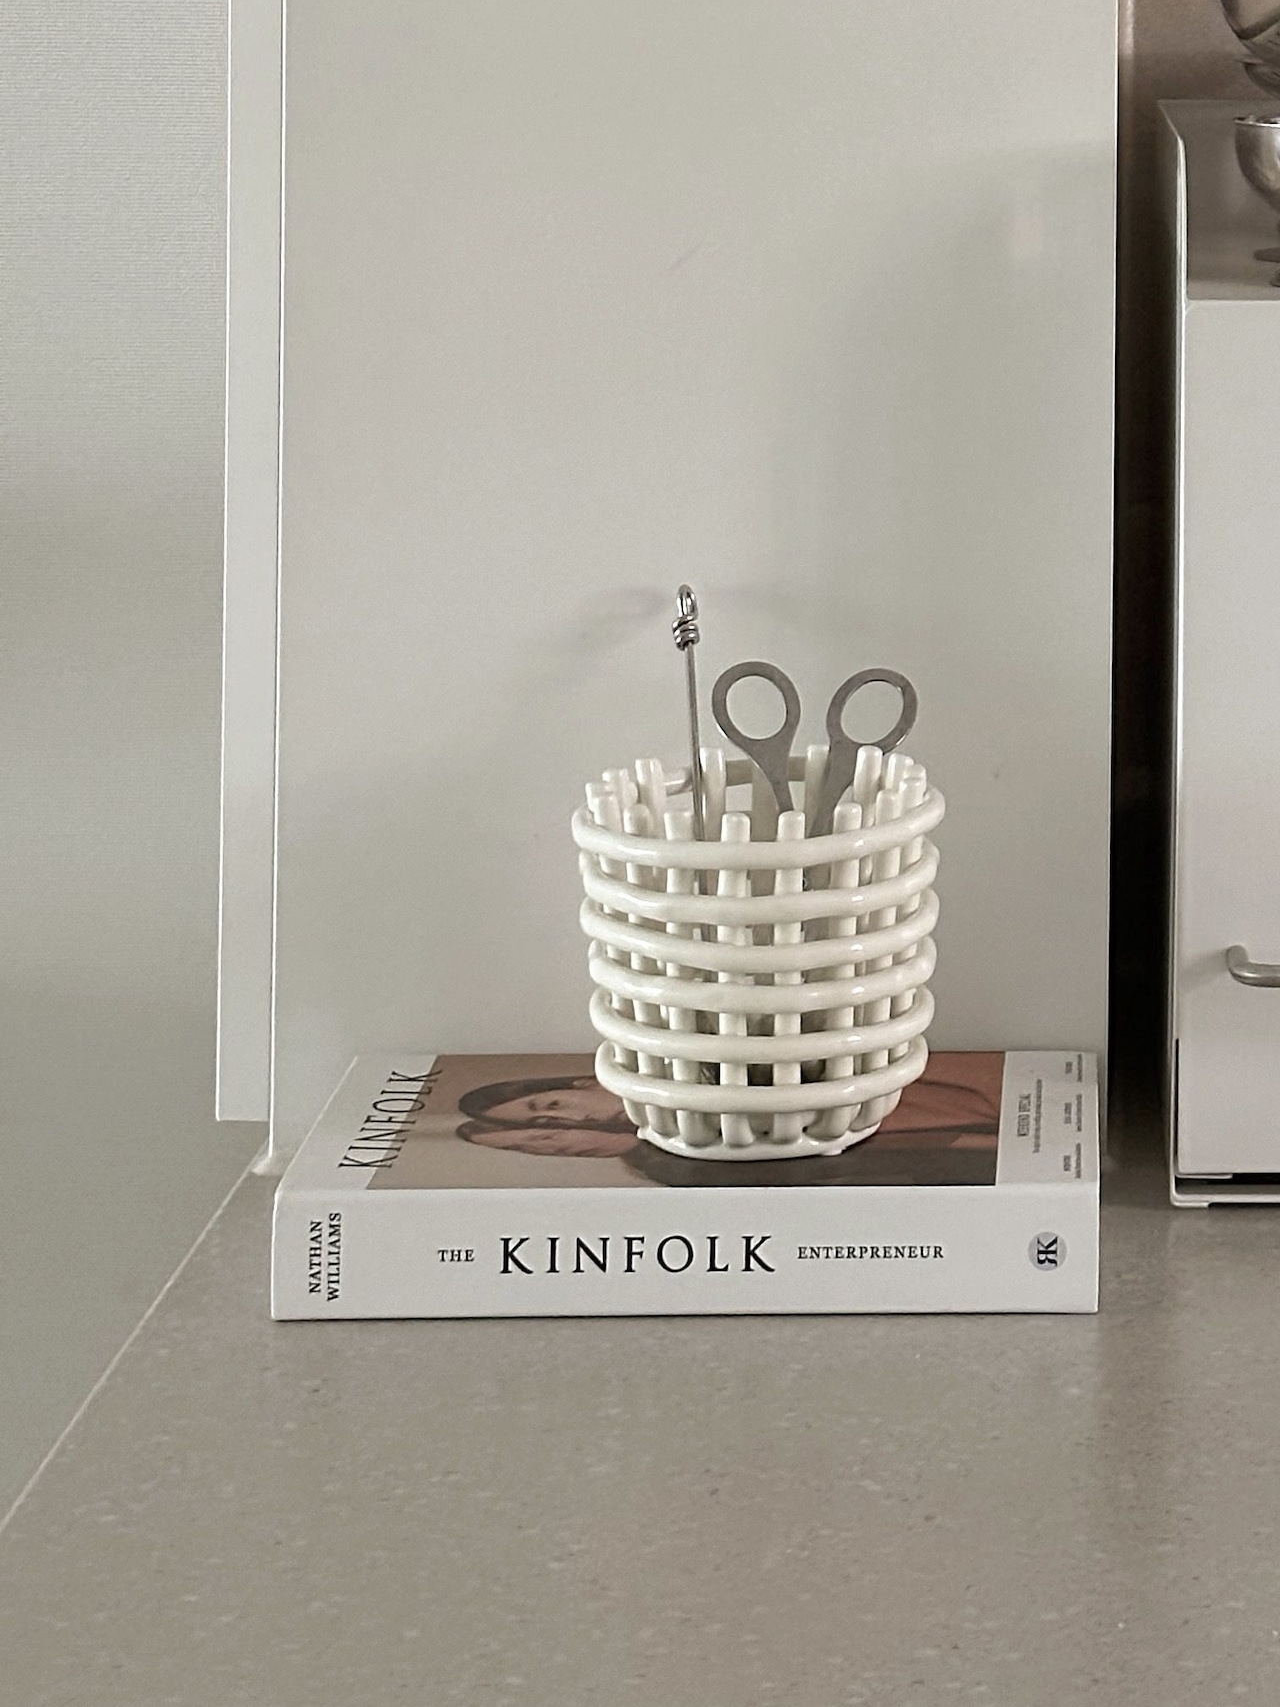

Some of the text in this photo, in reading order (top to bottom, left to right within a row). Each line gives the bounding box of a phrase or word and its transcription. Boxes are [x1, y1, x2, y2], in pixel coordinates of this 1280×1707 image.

[338, 1069, 443, 1168] KINFOLK
[308, 1220, 323, 1294] NATHAN
[326, 1212, 342, 1302] WILLIAMS
[437, 1235, 944, 1275] THE KINFOLK ENTERPRENEUR
